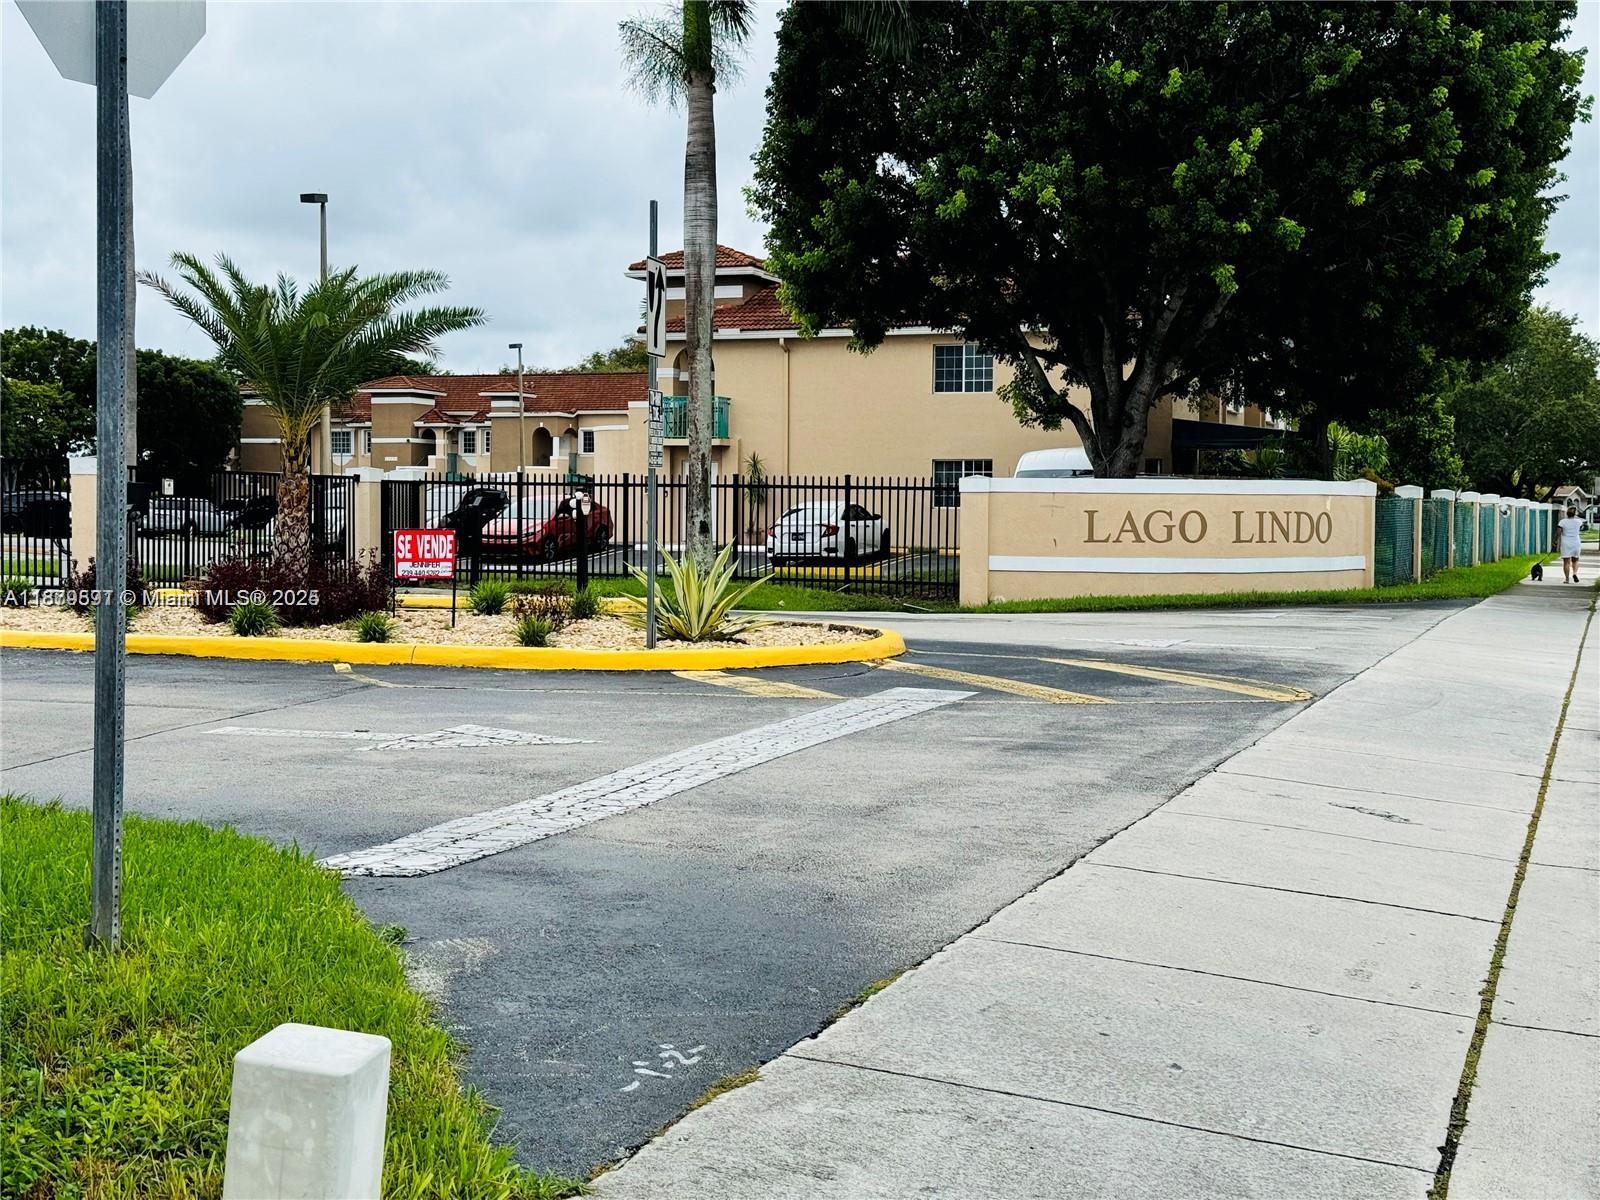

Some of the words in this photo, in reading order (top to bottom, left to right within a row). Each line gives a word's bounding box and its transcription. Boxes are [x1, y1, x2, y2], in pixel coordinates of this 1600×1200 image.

[1083, 509, 1208, 544] LAGO
[1231, 510, 1333, 544] LINDO
[397, 534, 413, 559] SE
[416, 534, 454, 559] VENDE
[409, 561, 441, 569] JENNIFER
